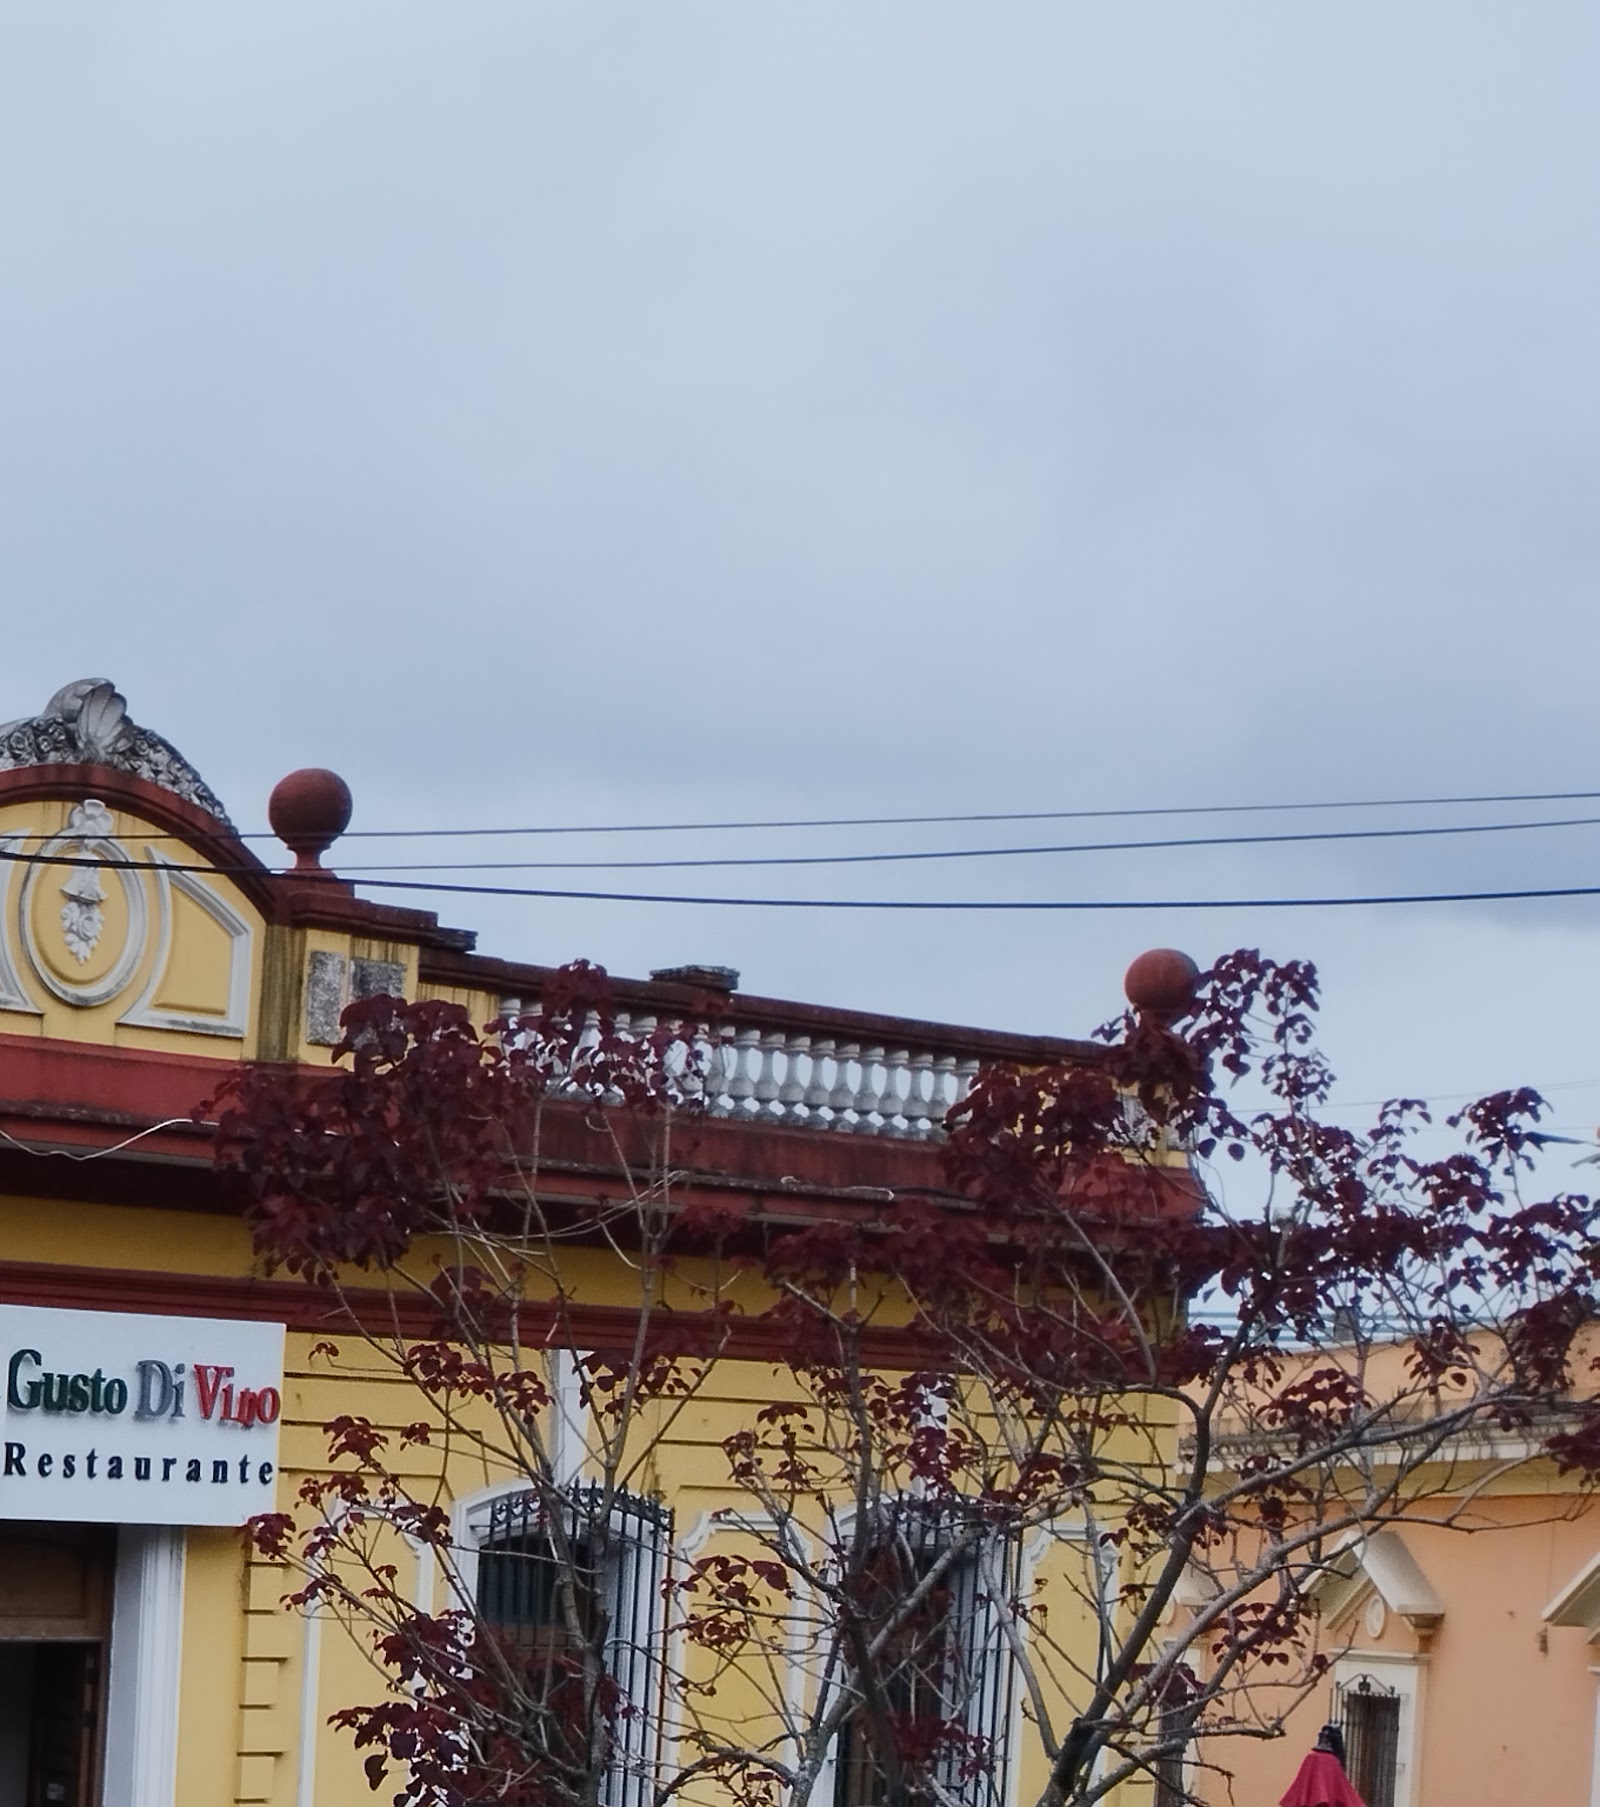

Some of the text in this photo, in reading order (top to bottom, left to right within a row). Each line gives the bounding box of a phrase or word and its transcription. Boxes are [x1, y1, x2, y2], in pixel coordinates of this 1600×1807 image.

[7, 1349, 281, 1427] Gusto Di Vino
[4, 1442, 273, 1485] Restaurante
